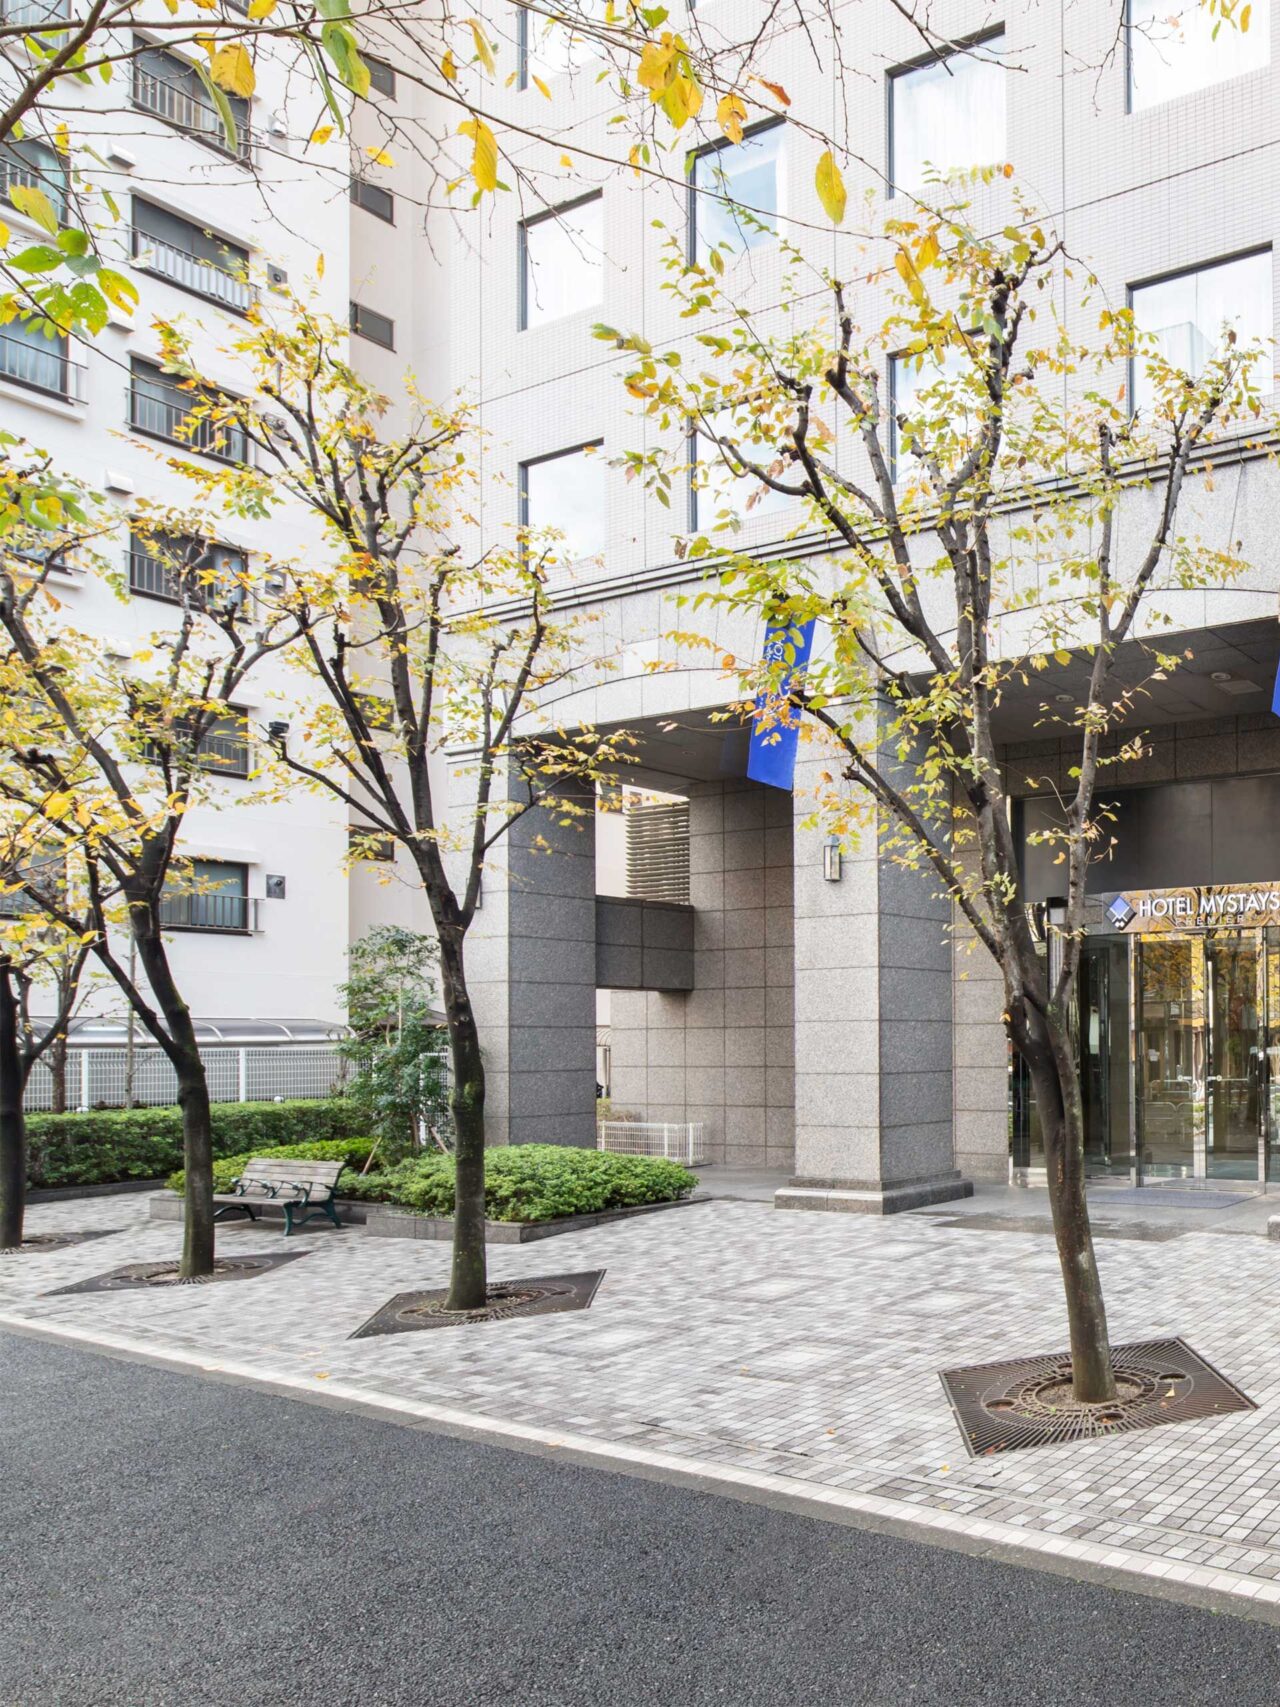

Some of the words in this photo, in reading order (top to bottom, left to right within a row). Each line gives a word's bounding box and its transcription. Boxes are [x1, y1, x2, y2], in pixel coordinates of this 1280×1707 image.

[1139, 897, 1194, 917] HOTEL
[1199, 891, 1280, 914] MYSTAYS
[1175, 914, 1244, 927] PREMIER
